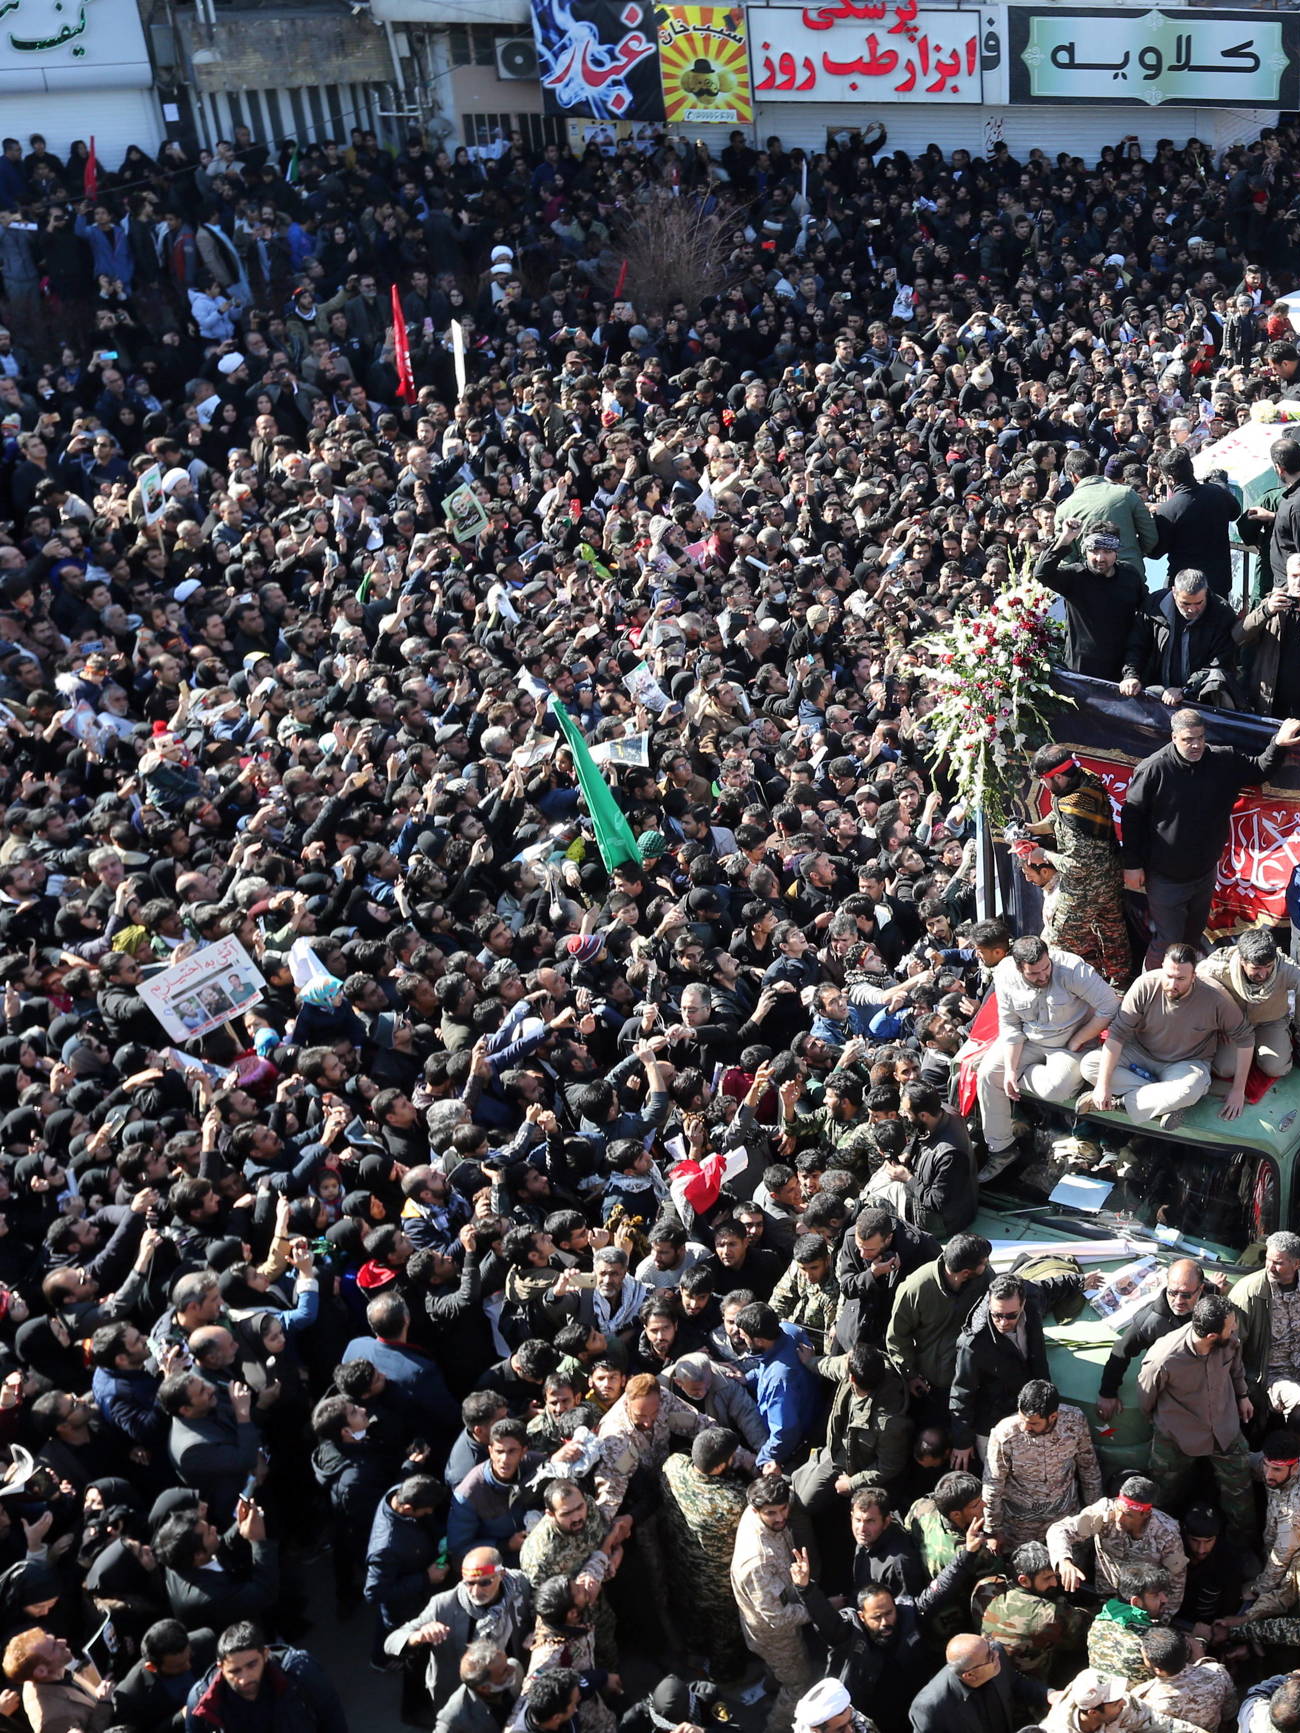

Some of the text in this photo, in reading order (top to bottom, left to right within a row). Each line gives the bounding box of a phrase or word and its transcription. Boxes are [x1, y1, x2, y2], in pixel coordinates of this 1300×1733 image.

[544, 4, 655, 112] غبار
[660, 20, 745, 46] سیب خان
[1050, 33, 1261, 81] کلاویه
[754, 41, 817, 91] روز
[822, 32, 899, 92] طب
[893, 33, 977, 94] ابزار
